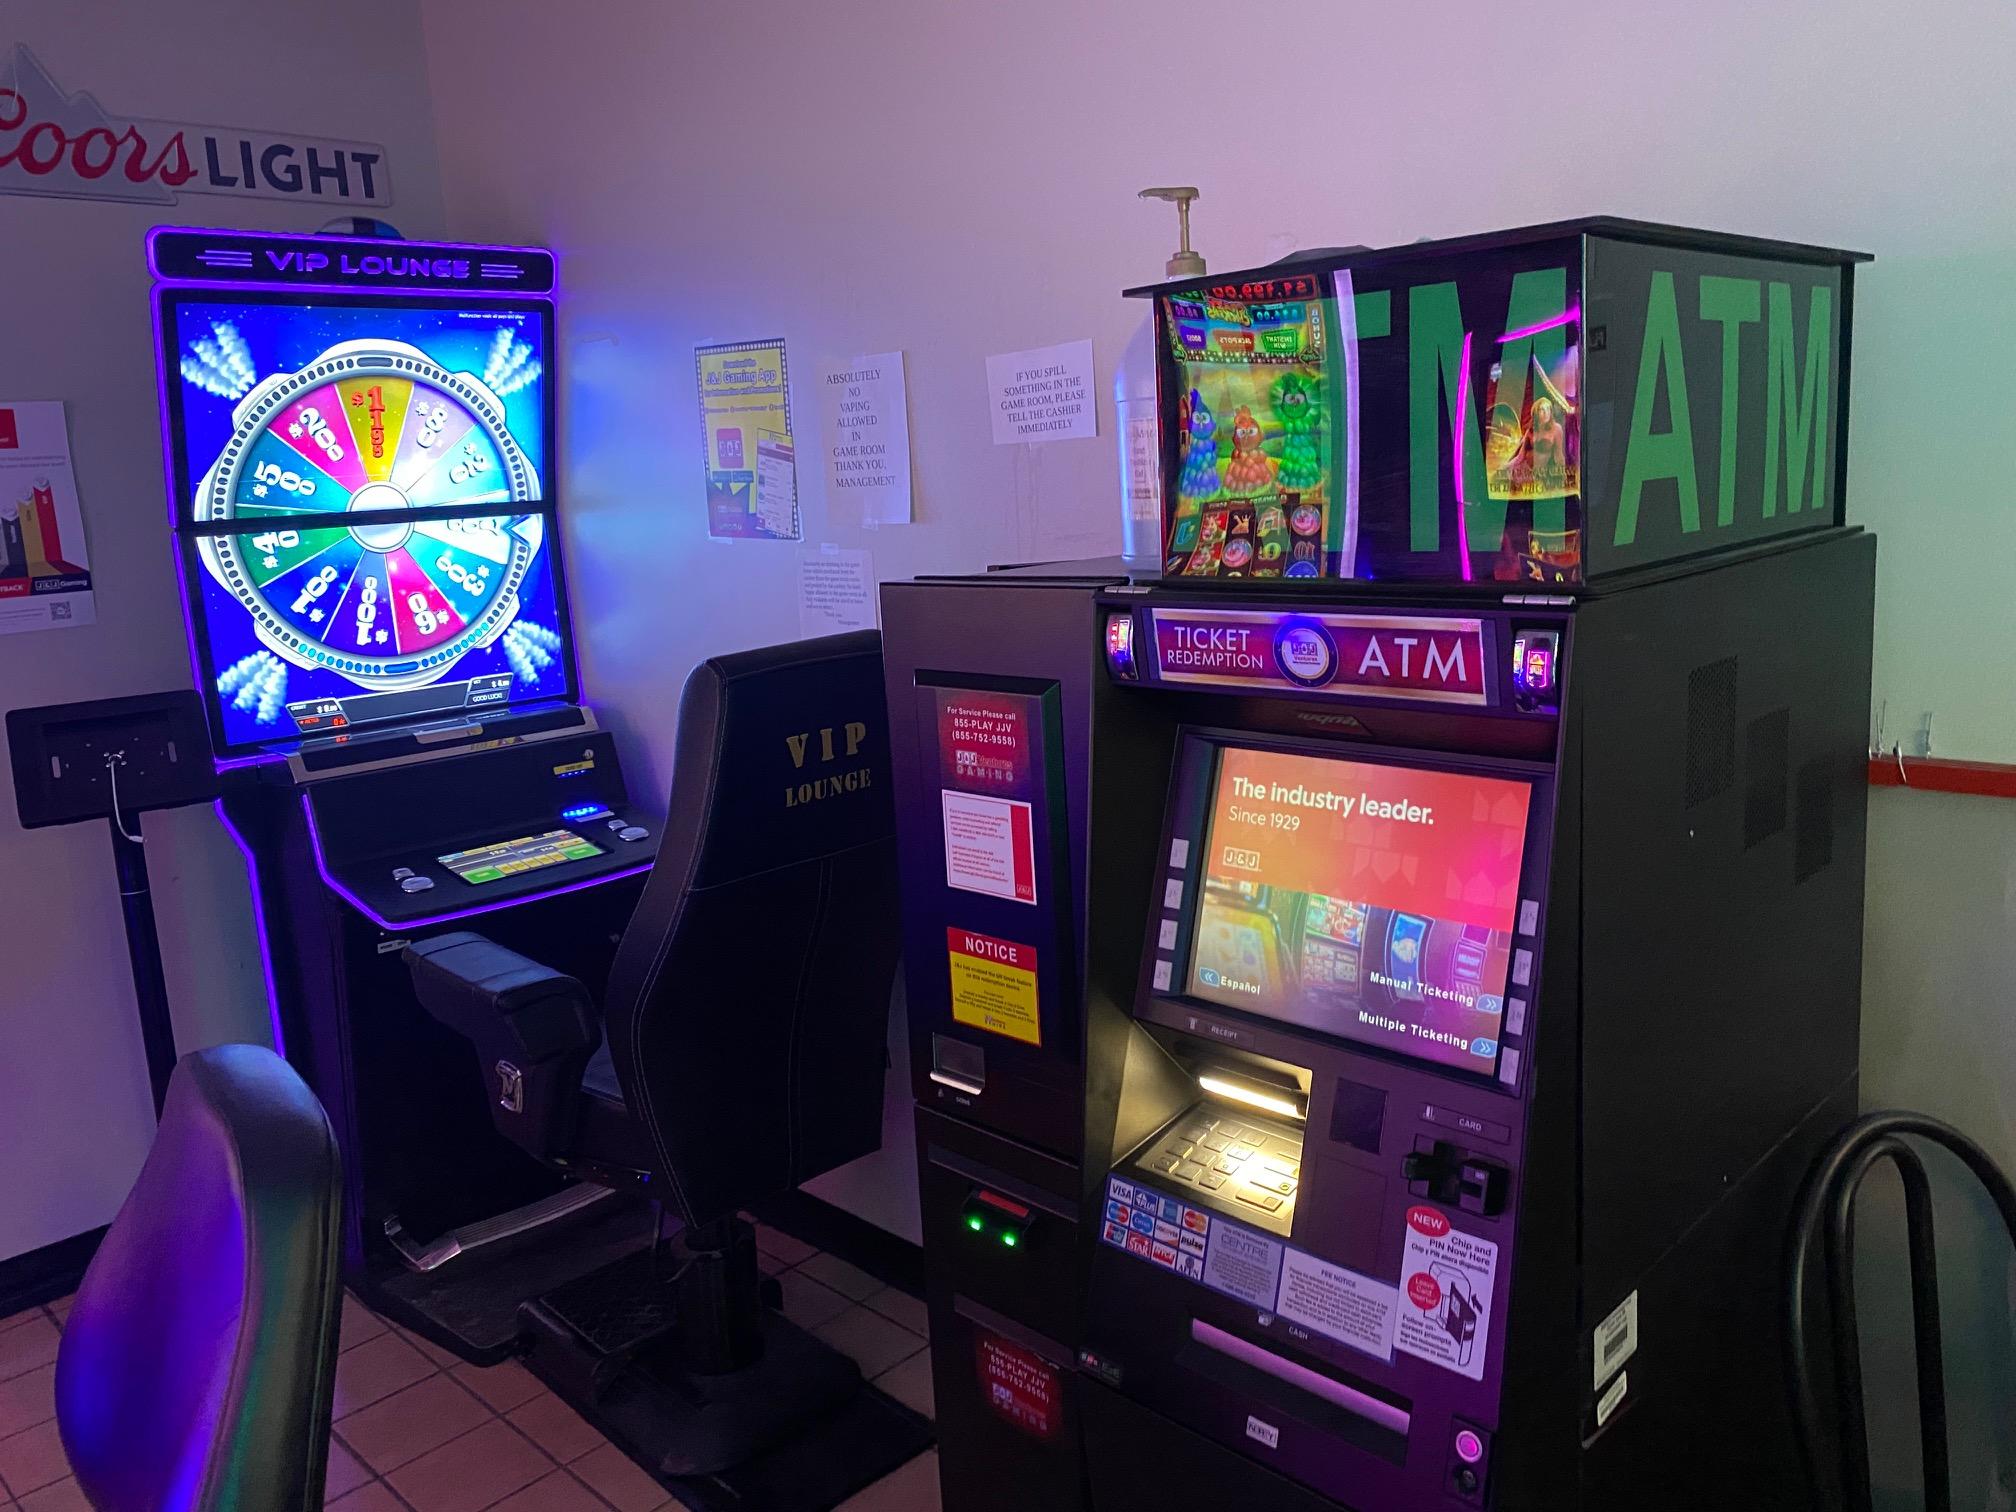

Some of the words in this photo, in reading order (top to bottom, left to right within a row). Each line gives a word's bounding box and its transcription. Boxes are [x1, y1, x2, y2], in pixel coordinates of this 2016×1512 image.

[204, 136, 380, 198] LIGHT
[266, 250, 329, 272] VIP
[341, 255, 470, 279] LOUNGE
[723, 369, 757, 385] Gaming
[758, 368, 777, 384] App
[826, 369, 881, 385] ABSOLUTELY
[1016, 372, 1024, 382] IF
[1025, 368, 1043, 380] YOU
[1044, 364, 1067, 377] SPILL
[848, 387, 861, 398] NO
[1004, 381, 1052, 397] SOMETHING
[1054, 379, 1063, 390] IN
[1064, 376, 1081, 388] THE
[840, 400, 871, 413] VAPING
[1000, 399, 1026, 411] GAME
[1055, 389, 1087, 403] PLEASE
[1613, 270, 1831, 546] ATM
[837, 415, 878, 428] ALLOWED
[1007, 412, 1028, 423] TELL
[1029, 408, 1045, 420] THE
[1046, 404, 1082, 417] CASHIER
[289, 406, 345, 463] $200
[415, 400, 448, 449] $80
[1018, 418, 1073, 434] IMMEDIATELY
[852, 431, 861, 441] IN
[833, 446, 859, 457] GAME
[860, 444, 886, 456] ROOM
[834, 461, 864, 472] THANK
[252, 460, 317, 498] $500
[836, 475, 896, 488] MANAGEMENT
[60, 579, 88, 588] Gaming
[435, 555, 490, 597] $300
[290, 565, 338, 623] $100
[356, 576, 389, 646] $1000
[407, 592, 450, 636] $60
[1174, 626, 1251, 652] TICKET
[1167, 650, 1264, 670] REDEMPTION
[1358, 636, 1467, 682] ATM
[947, 706, 958, 714] For
[958, 708, 981, 717] Service
[982, 710, 1003, 719] Please
[1004, 712, 1016, 720] call
[954, 718, 993, 732] 855-PLAY
[996, 722, 1012, 732] JJV
[786, 722, 866, 768] VIP
[785, 768, 872, 808] LOUNGE
[1232, 776, 1267, 800] The
[1270, 782, 1356, 818] industry
[1359, 793, 1435, 825] leader.
[1228, 806, 1266, 826] Since
[1270, 812, 1301, 832] 1929
[1225, 848, 1258, 869] J&J
[965, 936, 1018, 962] NOTICE
[1220, 976, 1261, 996] Español
[1370, 972, 1412, 992] Manual
[1416, 982, 1474, 1007] Ticketing
[1358, 1010, 1406, 1034] Multiple
[1410, 1024, 1468, 1050] Ticketing
[1458, 1118, 1482, 1132] CARD
[1112, 1183, 1132, 1199] VISA
[1413, 1212, 1443, 1230] NEW
[1129, 1240, 1149, 1256] STAR
[1221, 1234, 1269, 1258] CENTRE
[1411, 1242, 1424, 1254] Chip
[1429, 1238, 1445, 1251] PIN
[1448, 1244, 1468, 1259] Now
[1469, 1252, 1491, 1266] Here
[1451, 1236, 1472, 1250] Chip
[1474, 1242, 1492, 1256] and
[1334, 1274, 1357, 1288] NOTICE
[1288, 1326, 1308, 1340] CASH
